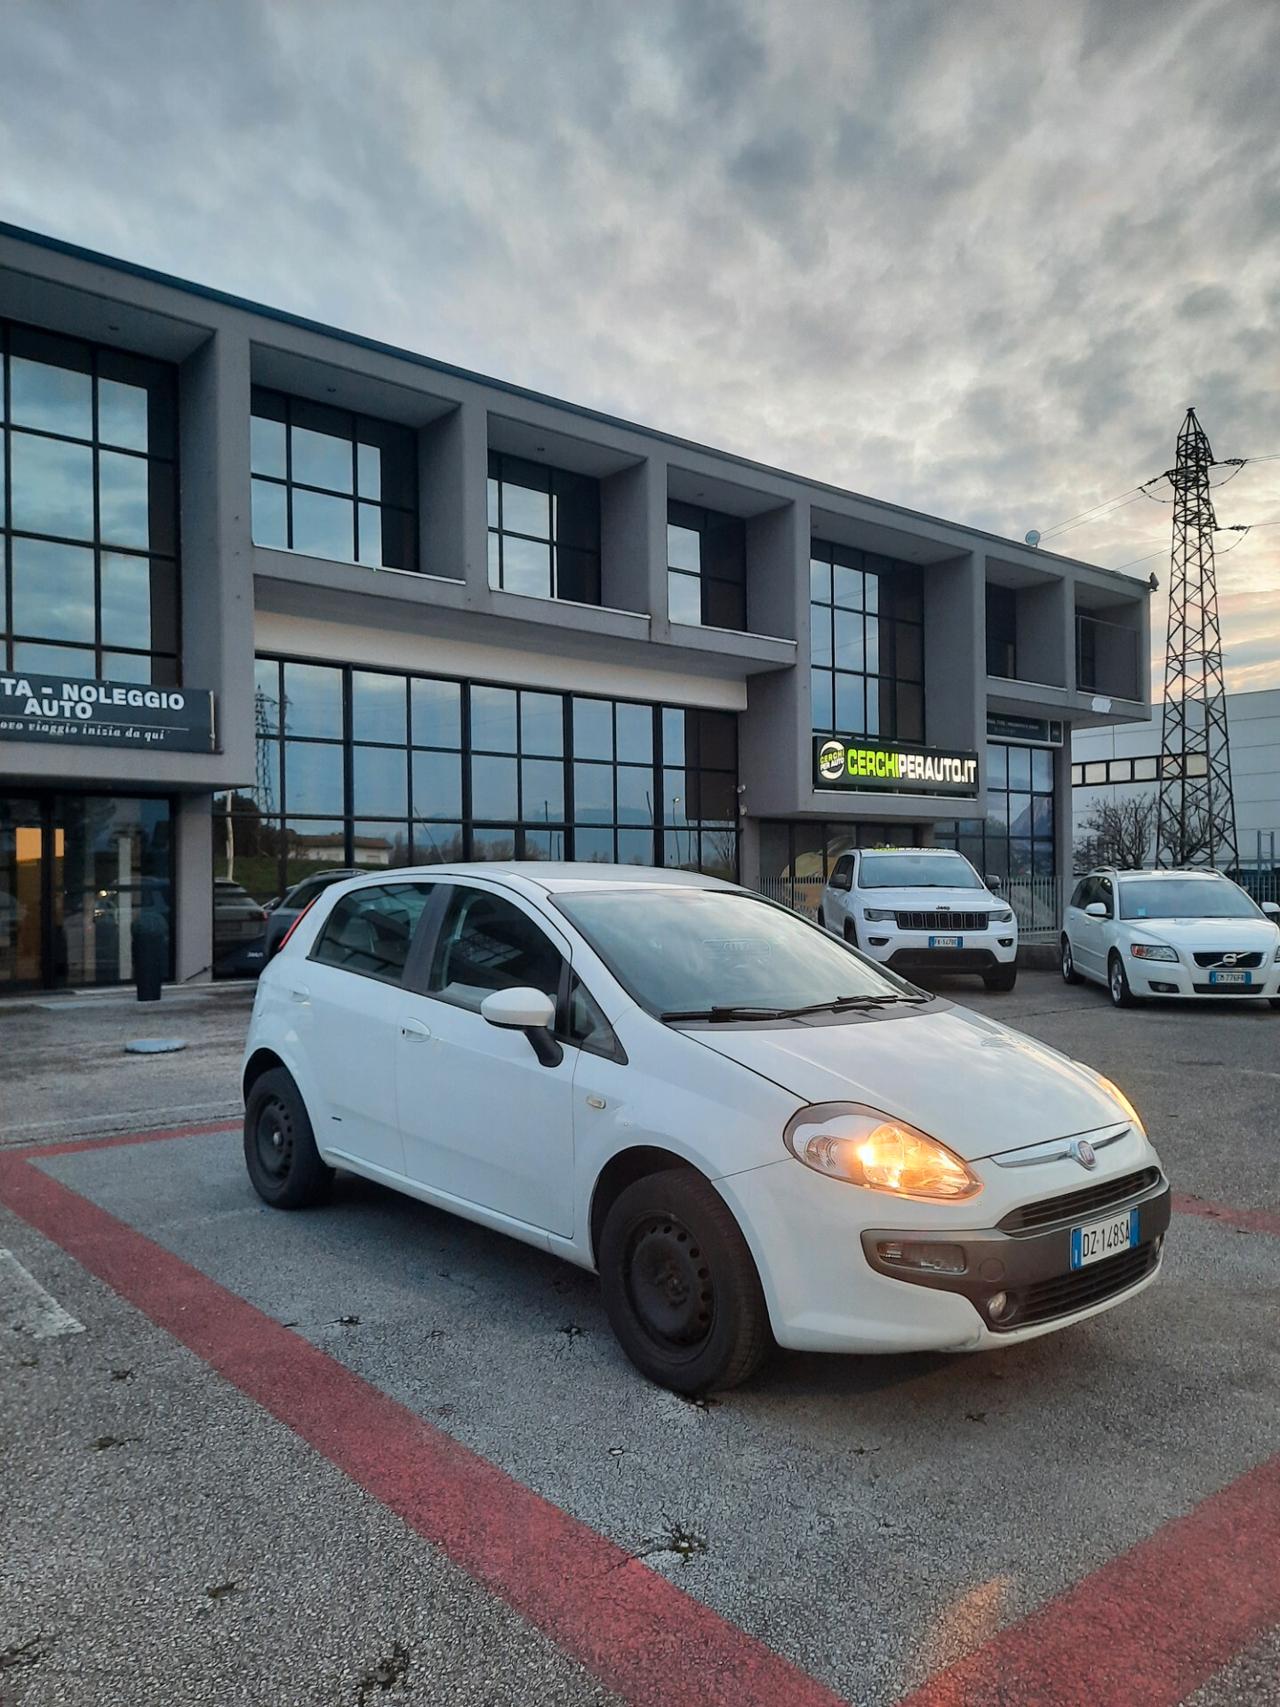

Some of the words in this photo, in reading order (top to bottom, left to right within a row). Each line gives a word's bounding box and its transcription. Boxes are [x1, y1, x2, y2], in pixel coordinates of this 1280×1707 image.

[62, 683, 185, 710] NOLEGGIO
[24, 698, 93, 719] AUTO
[28, 720, 78, 736] viaggio
[82, 723, 121, 737] inizia
[125, 728, 141, 739] da
[144, 729, 165, 742] qui
[819, 748, 845, 765] CERCHI
[847, 748, 977, 784] CERCHIPERAUTO.IT
